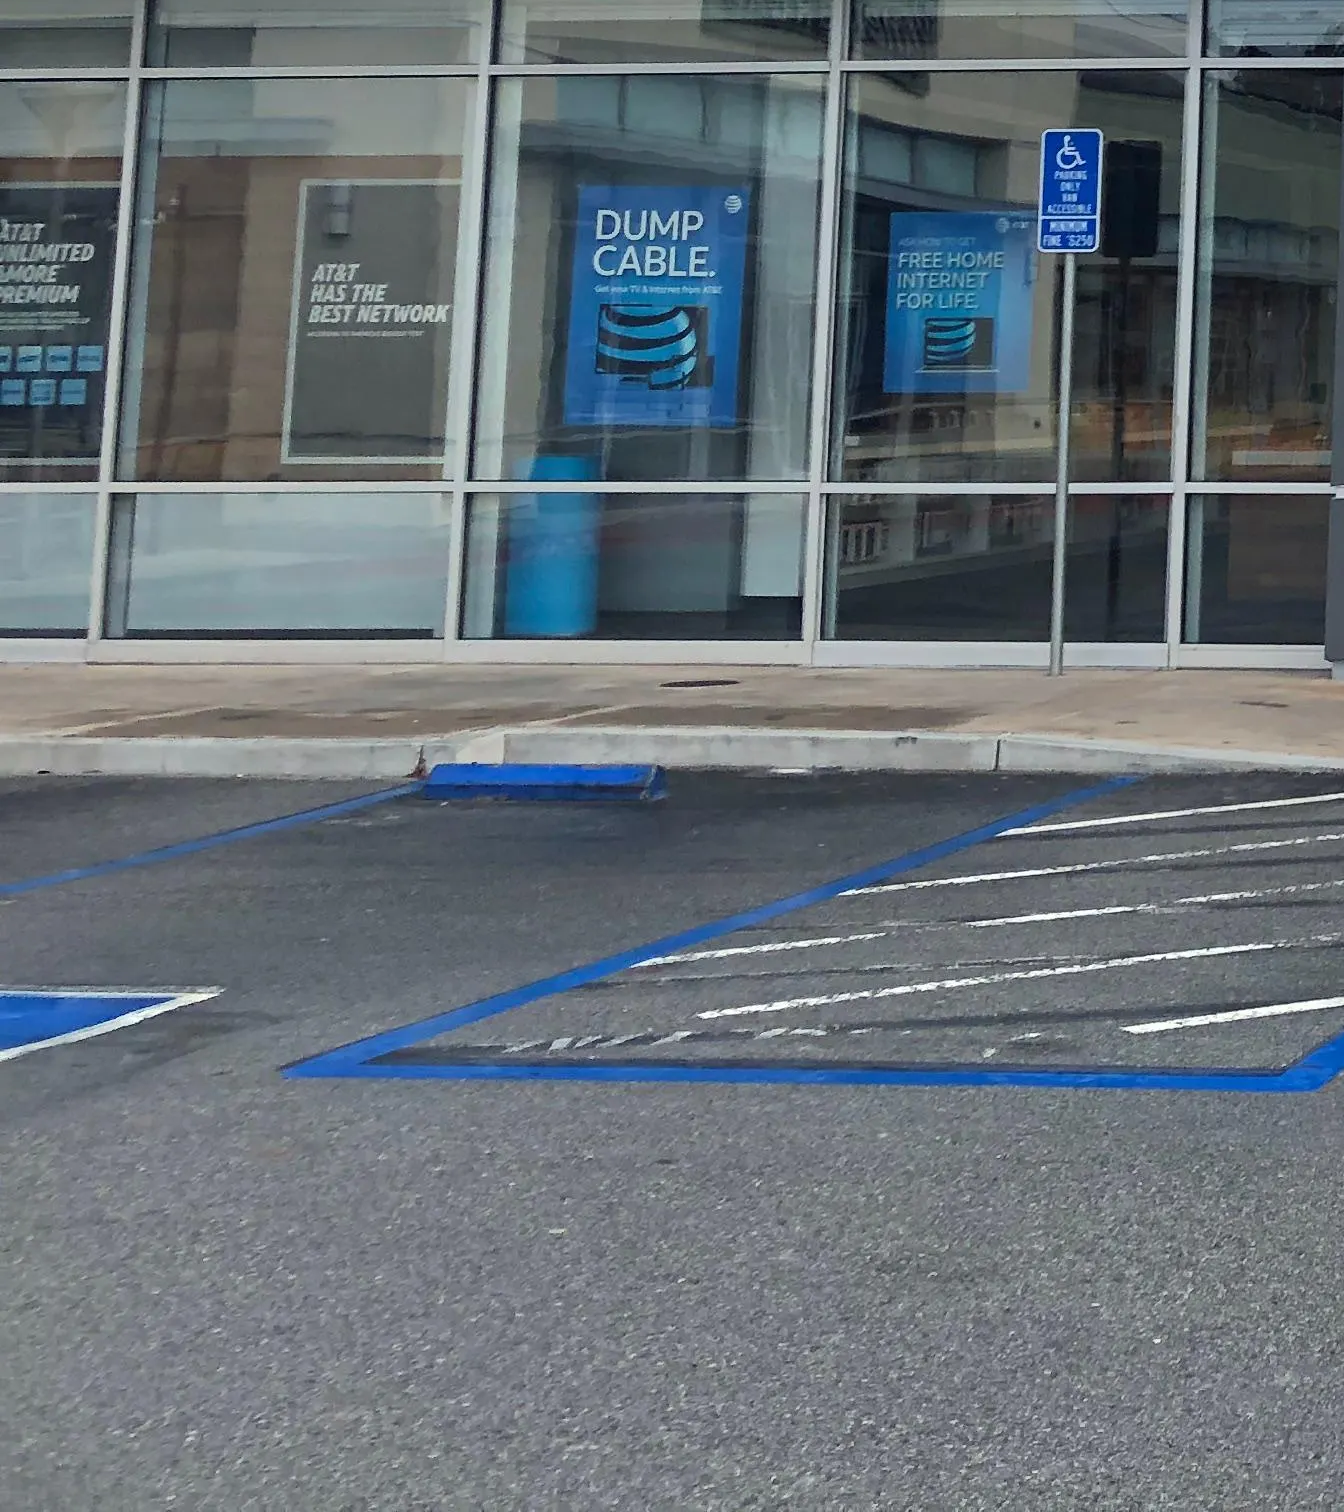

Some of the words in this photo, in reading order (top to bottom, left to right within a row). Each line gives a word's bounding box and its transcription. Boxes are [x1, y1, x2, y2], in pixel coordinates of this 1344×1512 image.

[595, 209, 704, 241] DUMP
[593, 245, 717, 277] CABLE.
[899, 252, 943, 269] FREE
[948, 252, 1005, 269] HOME
[312, 263, 360, 282] AT&T
[897, 272, 990, 289] INTERNET
[311, 284, 347, 303] HAS
[352, 284, 388, 303] THE
[896, 292, 935, 309] FOR
[308, 304, 355, 323] BEST
[356, 304, 451, 323] NETWORK
